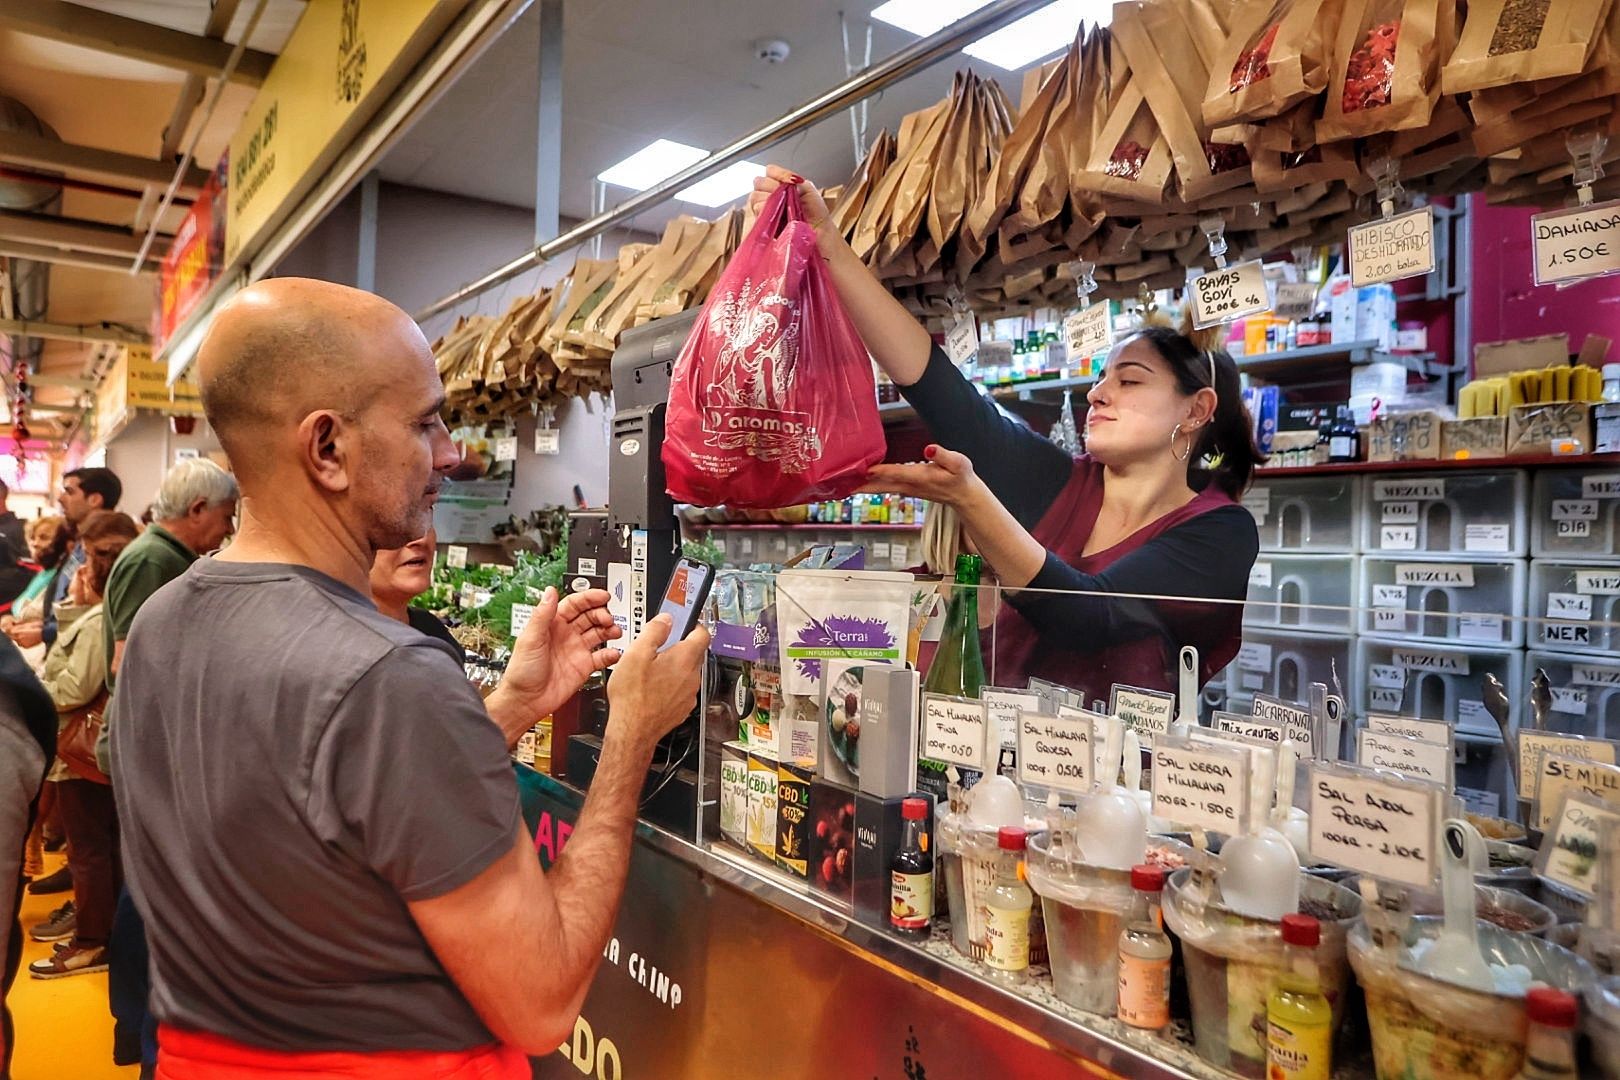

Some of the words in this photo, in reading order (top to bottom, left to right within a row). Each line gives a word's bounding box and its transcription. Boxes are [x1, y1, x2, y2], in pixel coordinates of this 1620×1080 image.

[1196, 272, 1240, 291] BAYAS
[1383, 486, 1440, 497] MEZCLA
[1560, 520, 1586, 533] DIA
[1404, 571, 1462, 582] MEZCLA
[833, 630, 864, 642] Terra
[1547, 626, 1588, 641] NER
[721, 767, 738, 783] CBD
[748, 776, 767, 794] CBD
[778, 784, 799, 804] CBD
